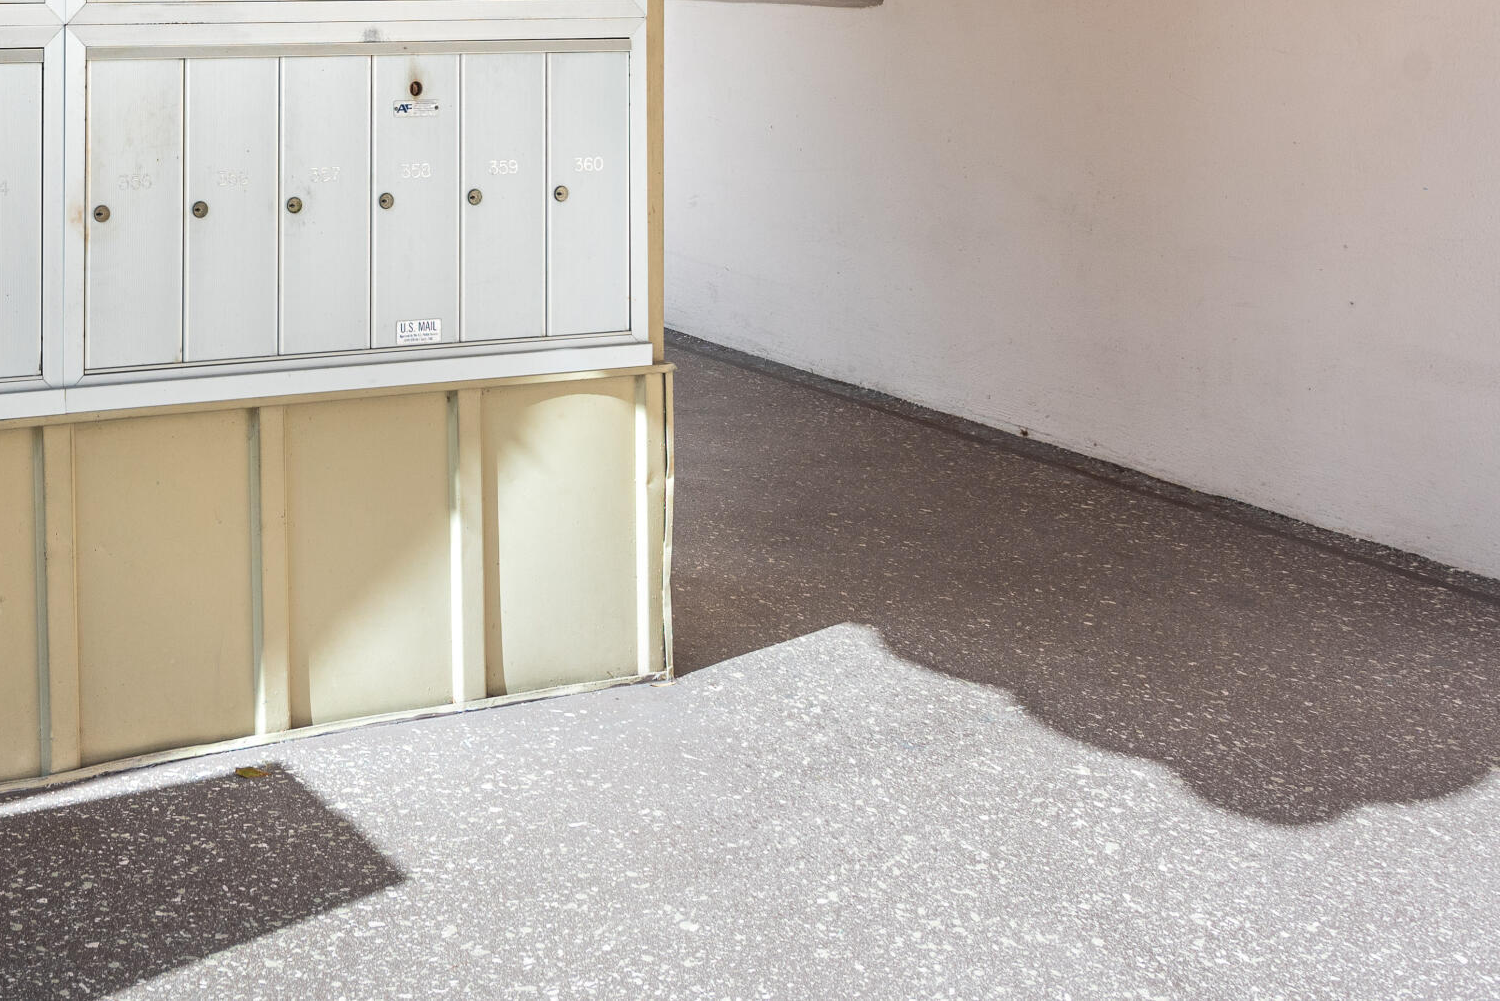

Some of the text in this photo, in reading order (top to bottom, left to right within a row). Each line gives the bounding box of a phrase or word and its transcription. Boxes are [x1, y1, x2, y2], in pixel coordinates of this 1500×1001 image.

[489, 160, 518, 176] 359
[574, 157, 605, 173] 360
[418, 320, 437, 332] MAIL
